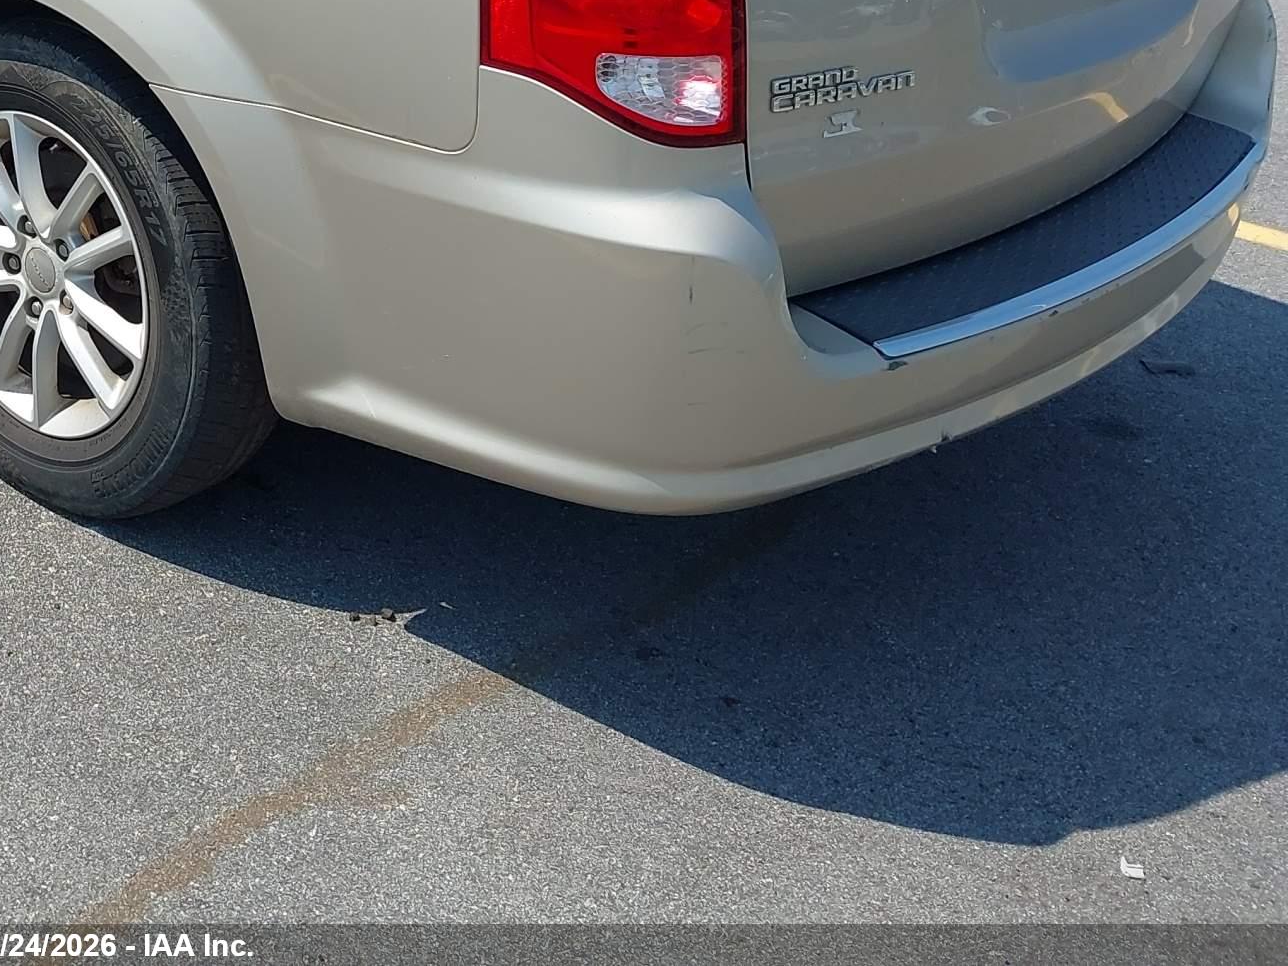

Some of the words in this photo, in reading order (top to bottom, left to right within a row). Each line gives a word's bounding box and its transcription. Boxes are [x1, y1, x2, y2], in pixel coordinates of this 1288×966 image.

[769, 70, 918, 113] CARAVAN
[770, 65, 859, 95] GRAND
[73, 93, 167, 242] 225/65R17
